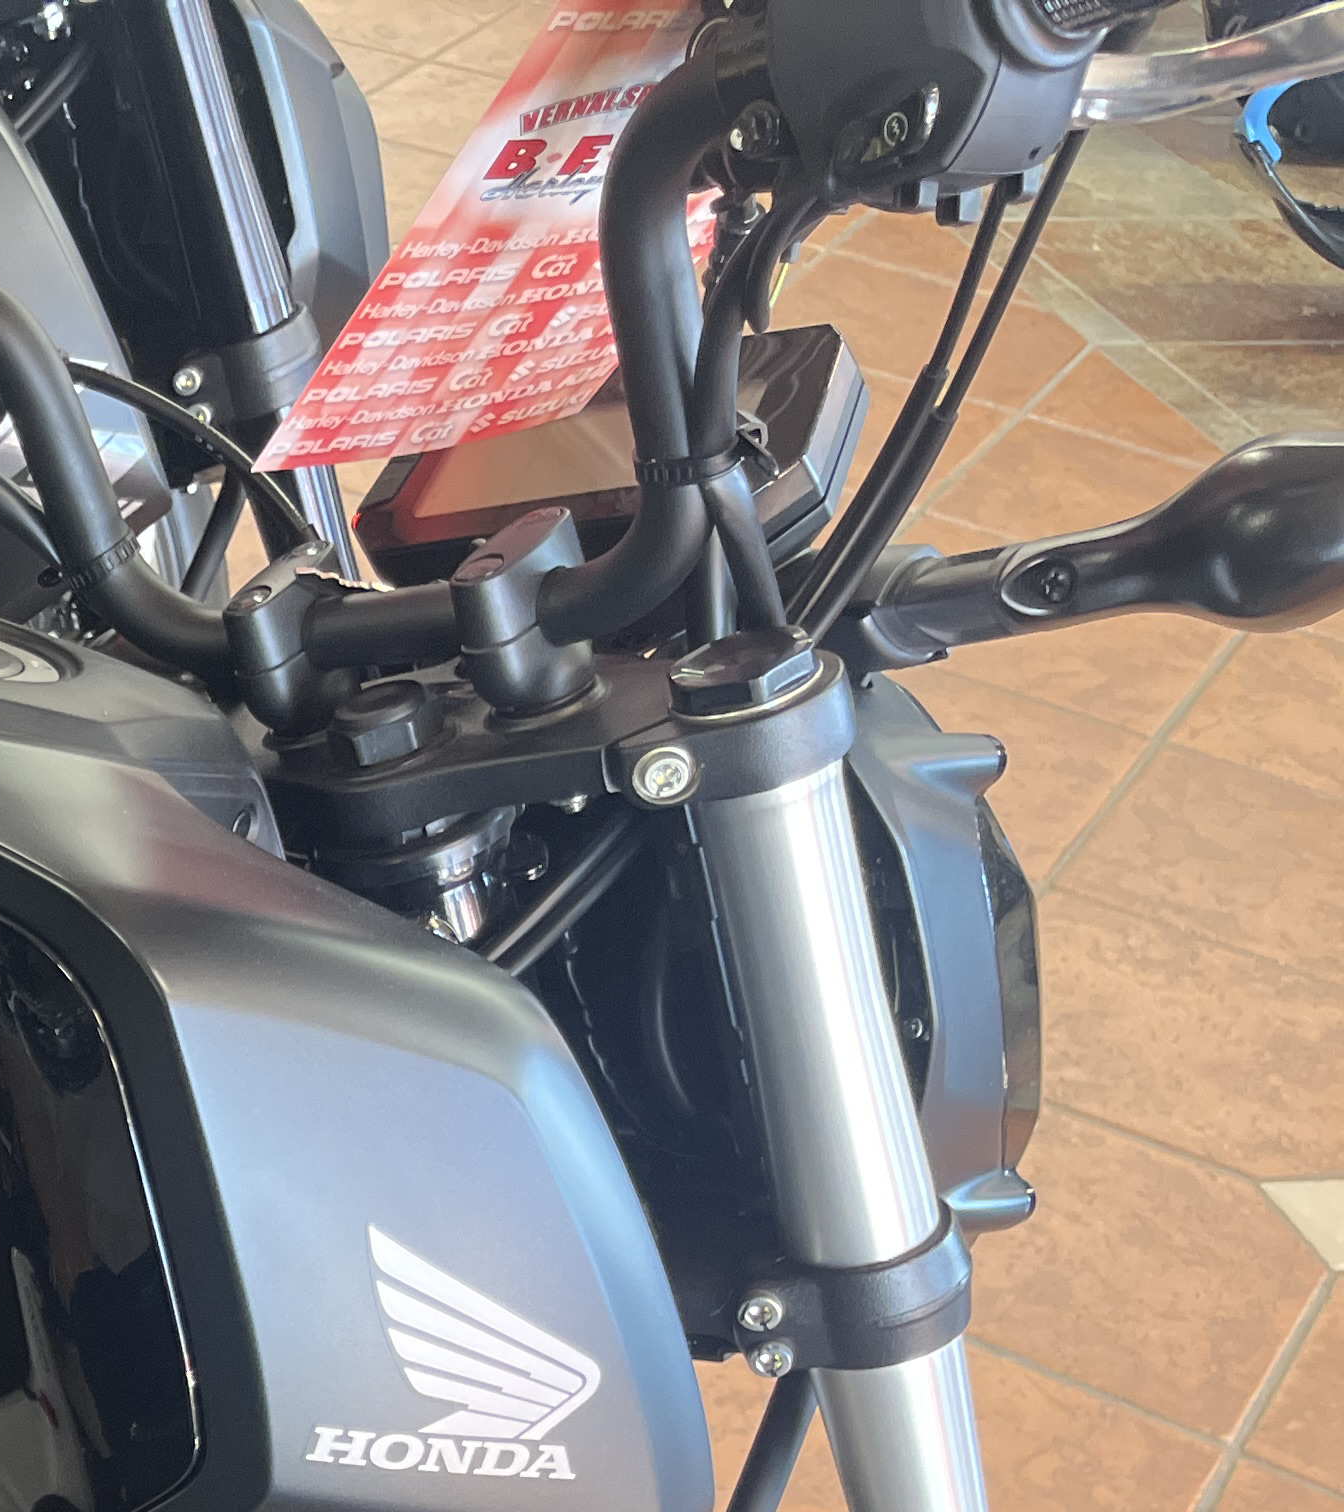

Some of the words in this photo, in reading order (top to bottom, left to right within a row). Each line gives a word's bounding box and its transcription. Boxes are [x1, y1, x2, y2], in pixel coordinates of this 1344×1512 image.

[520, 88, 621, 136] VERNAL
[400, 234, 556, 260] Harley-Davidson
[378, 264, 520, 290] POLARIS
[359, 294, 516, 320] Harley-Davidson
[321, 350, 477, 376] Harley-Davidson
[476, 327, 594, 362] HONDA
[338, 322, 478, 349] POLARIS
[285, 403, 437, 430] Harley-Davidson
[435, 380, 553, 414] HONDA
[302, 377, 438, 405] POLARIS
[266, 429, 401, 458] POLARIS
[496, 389, 594, 425] SUZUKI
[305, 1426, 577, 1481] HONDA
